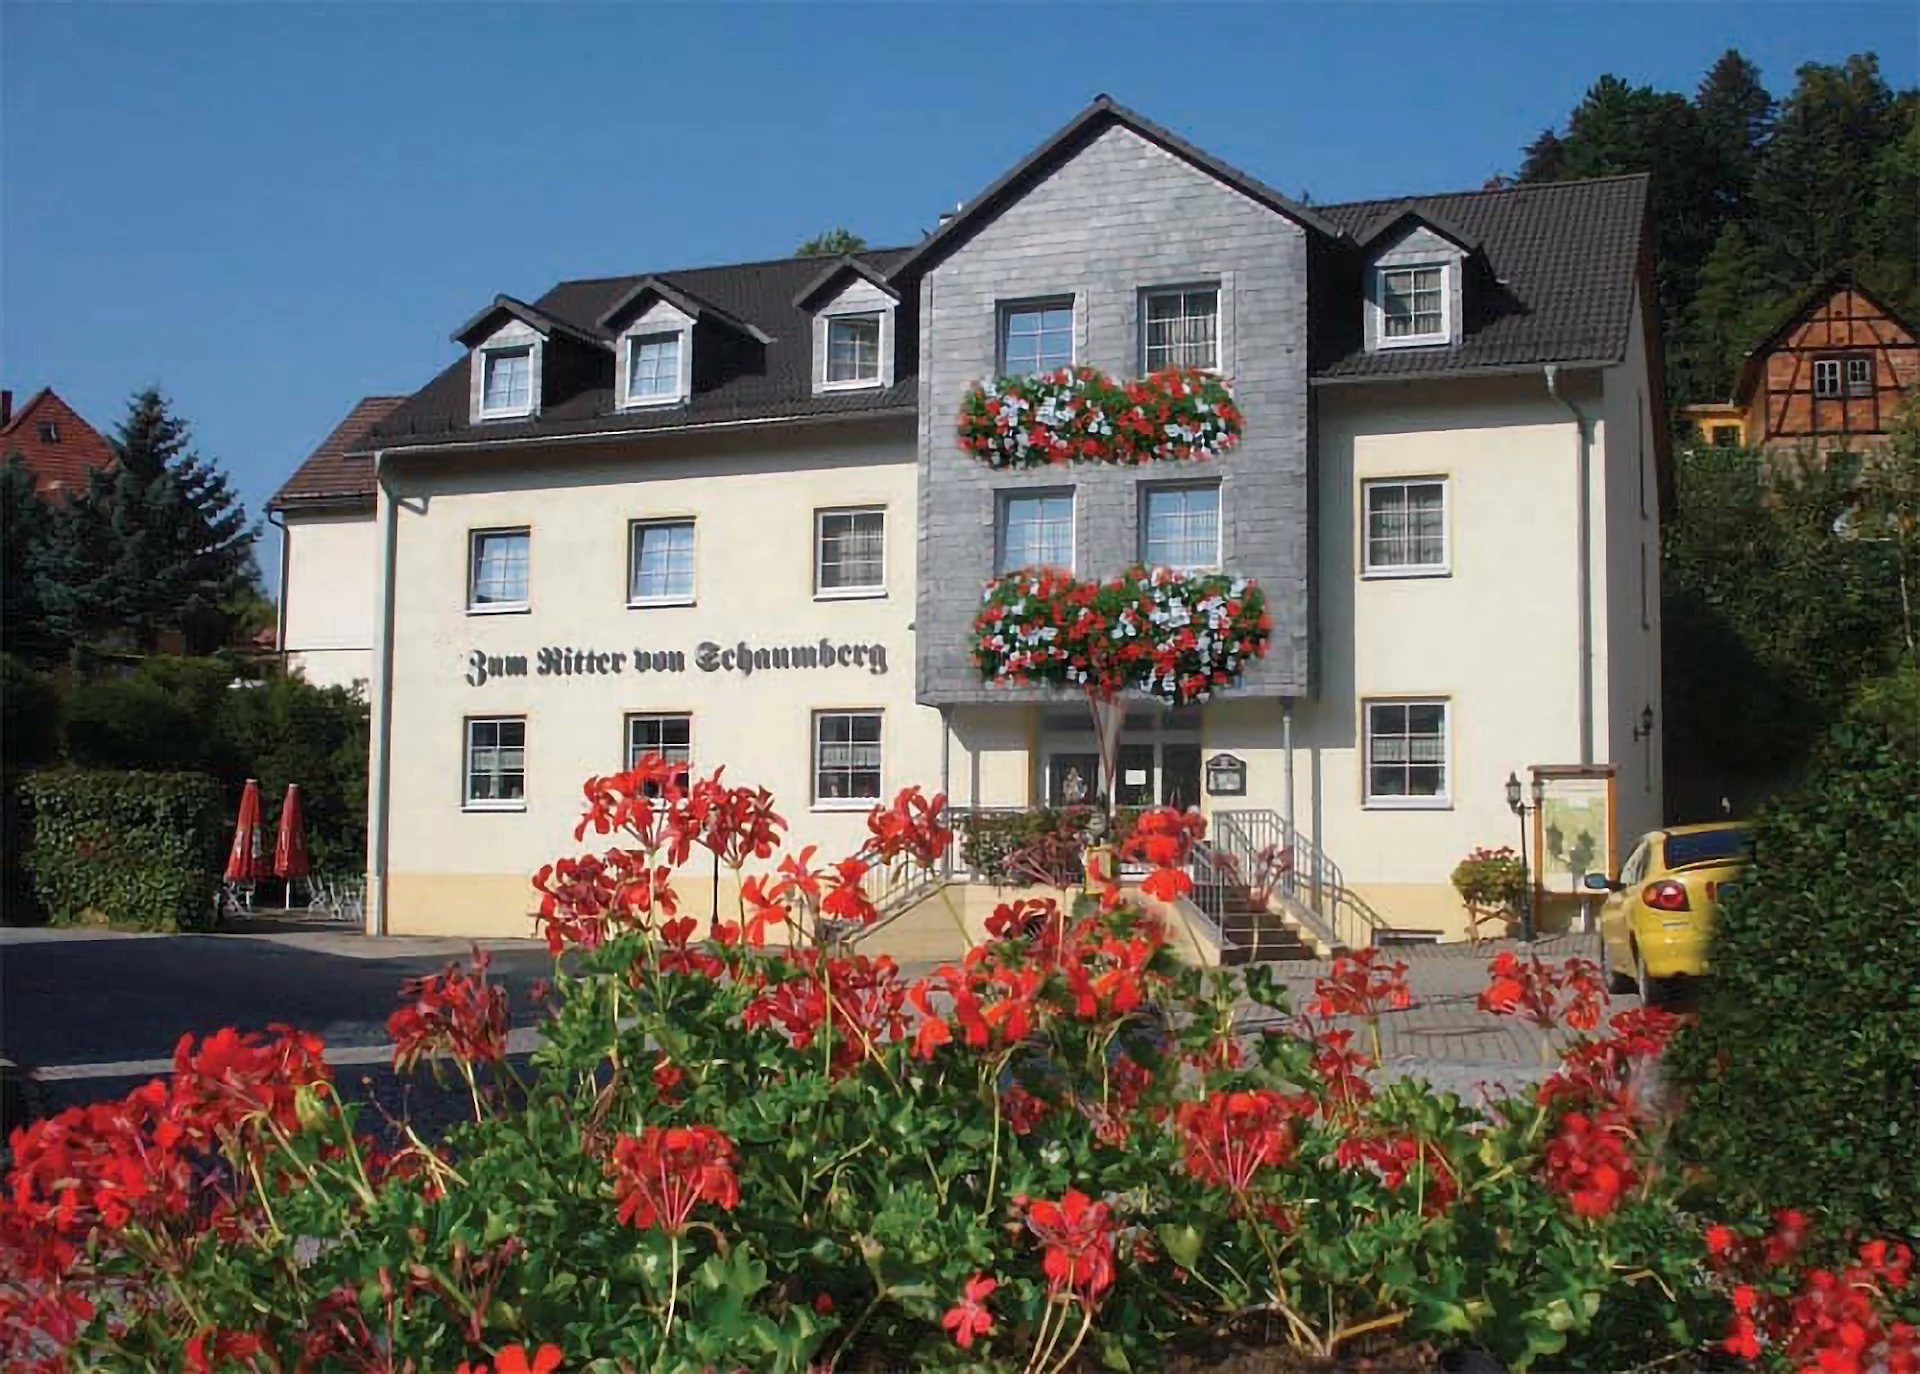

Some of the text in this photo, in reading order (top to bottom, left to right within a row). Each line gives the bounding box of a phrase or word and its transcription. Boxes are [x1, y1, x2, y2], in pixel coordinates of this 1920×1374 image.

[465, 638, 888, 687] Zum Ritter von Schaumberg
